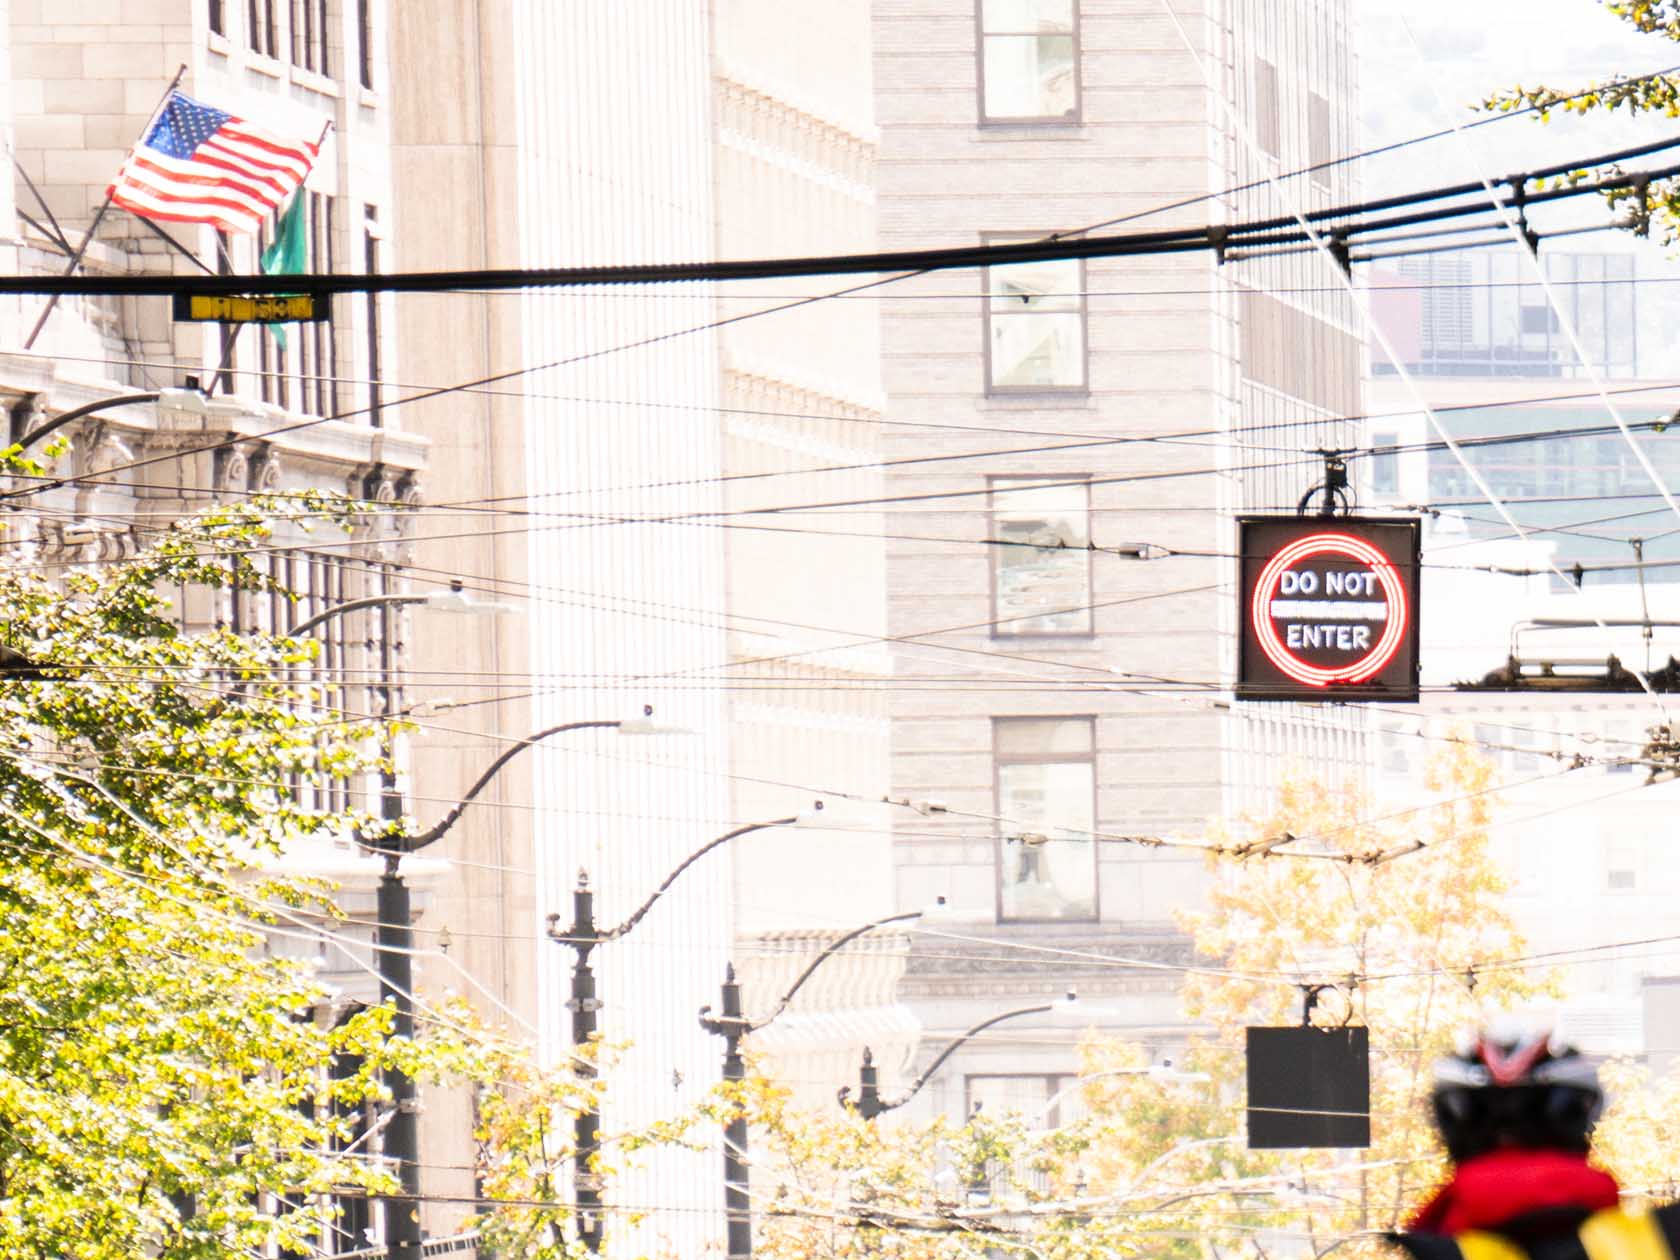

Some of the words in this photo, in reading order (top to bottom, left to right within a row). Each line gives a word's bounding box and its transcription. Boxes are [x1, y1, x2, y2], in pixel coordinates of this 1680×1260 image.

[1280, 570, 1316, 595] DO
[1325, 570, 1377, 596] NOT
[1286, 624, 1370, 650] ENTER
